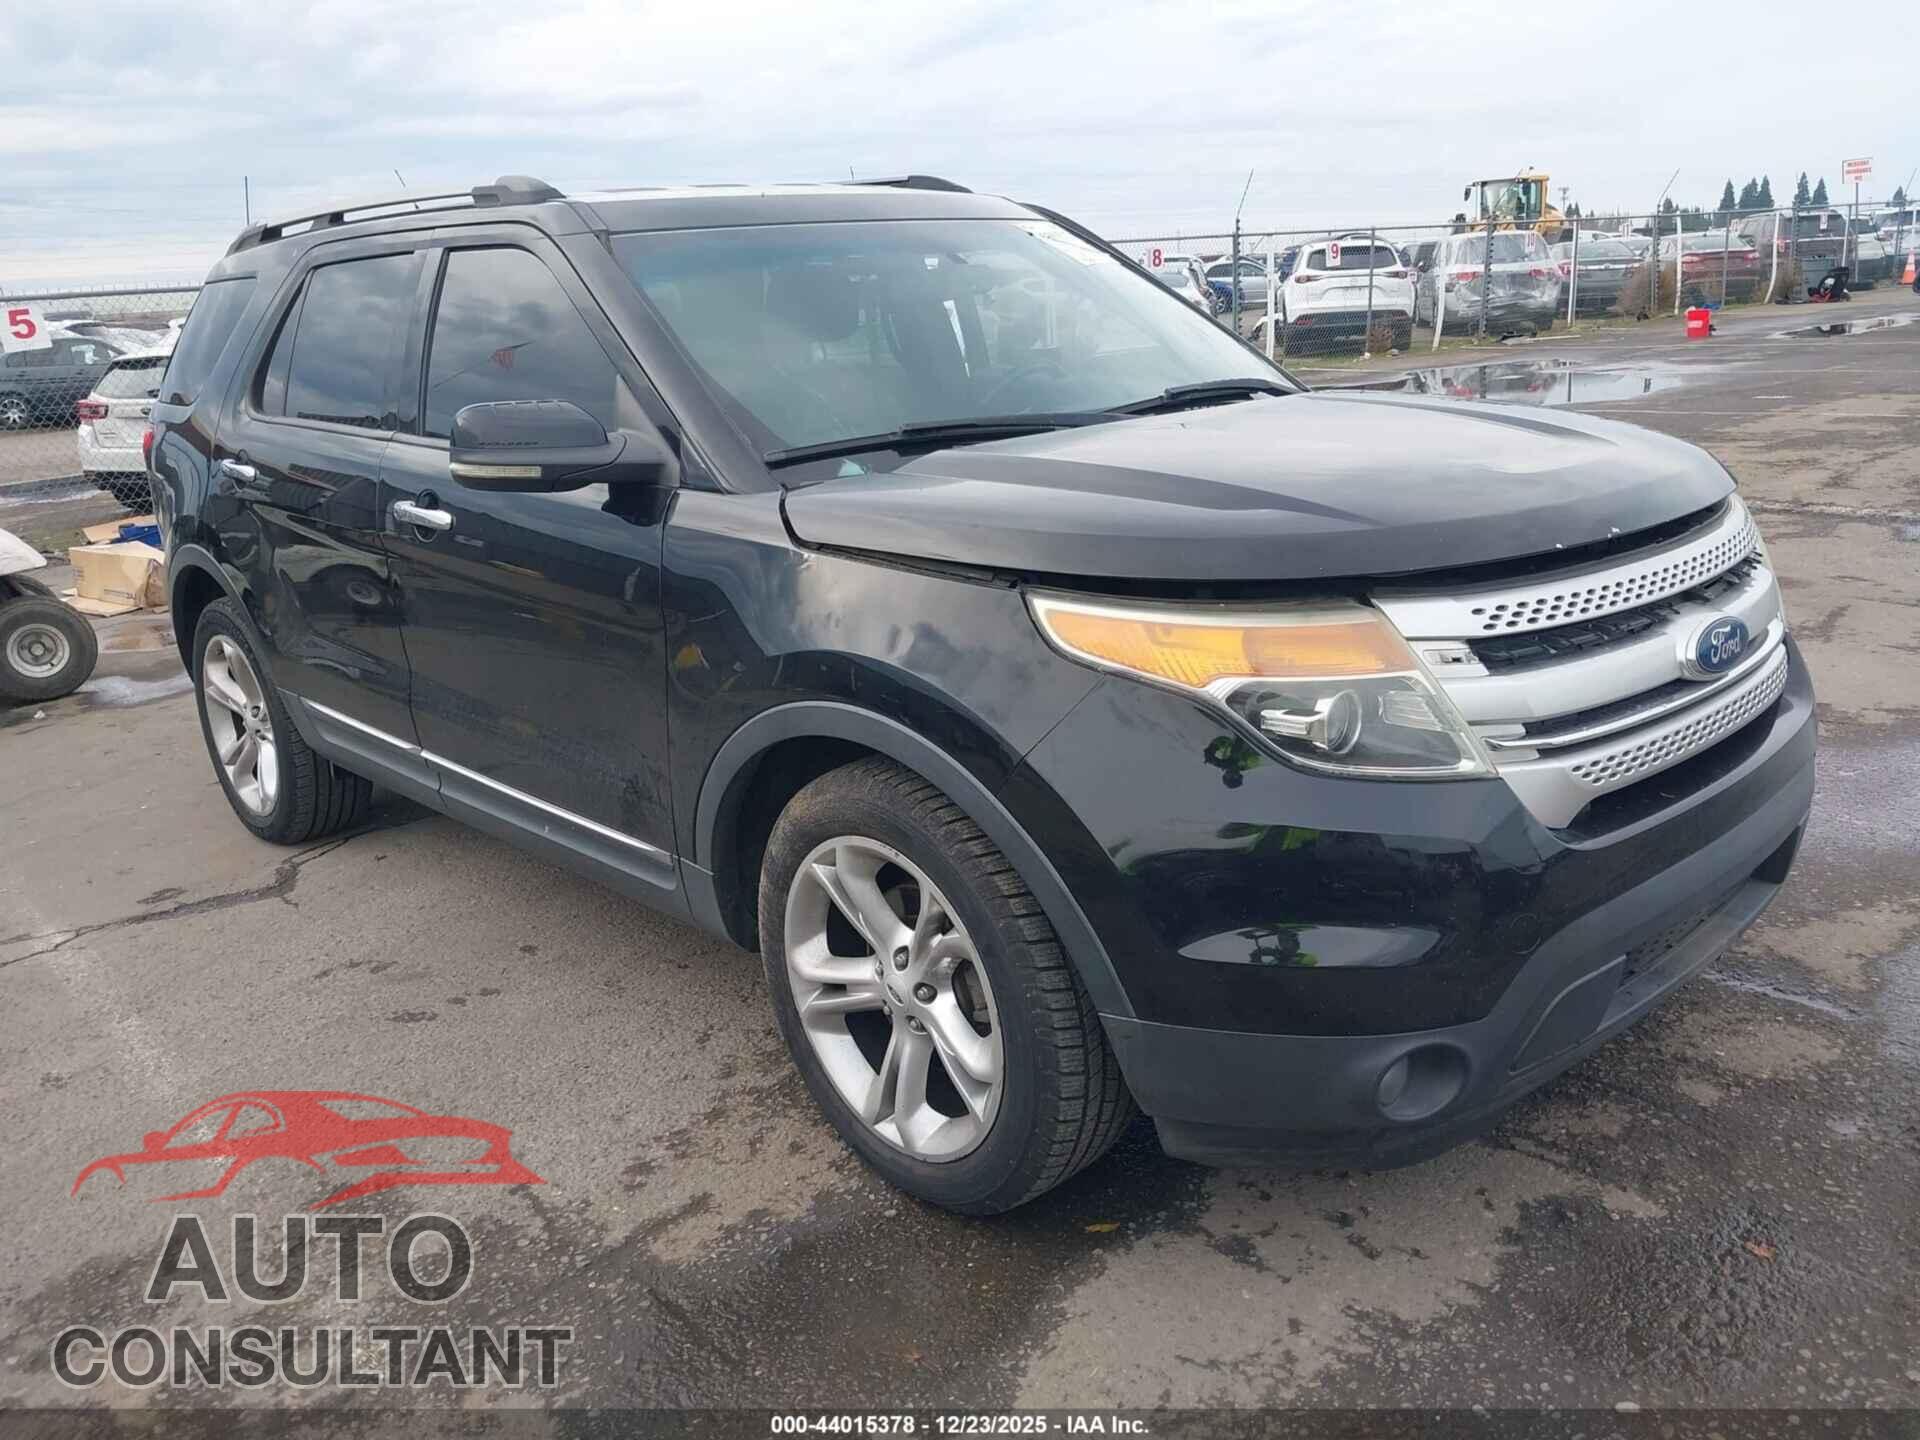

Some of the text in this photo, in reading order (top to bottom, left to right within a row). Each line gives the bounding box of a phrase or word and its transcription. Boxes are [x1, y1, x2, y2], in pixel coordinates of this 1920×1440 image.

[1152, 249, 1162, 267] 8
[1331, 243, 1339, 259] 9
[8, 308, 37, 340] 5
[1710, 624, 1741, 665] Ford
